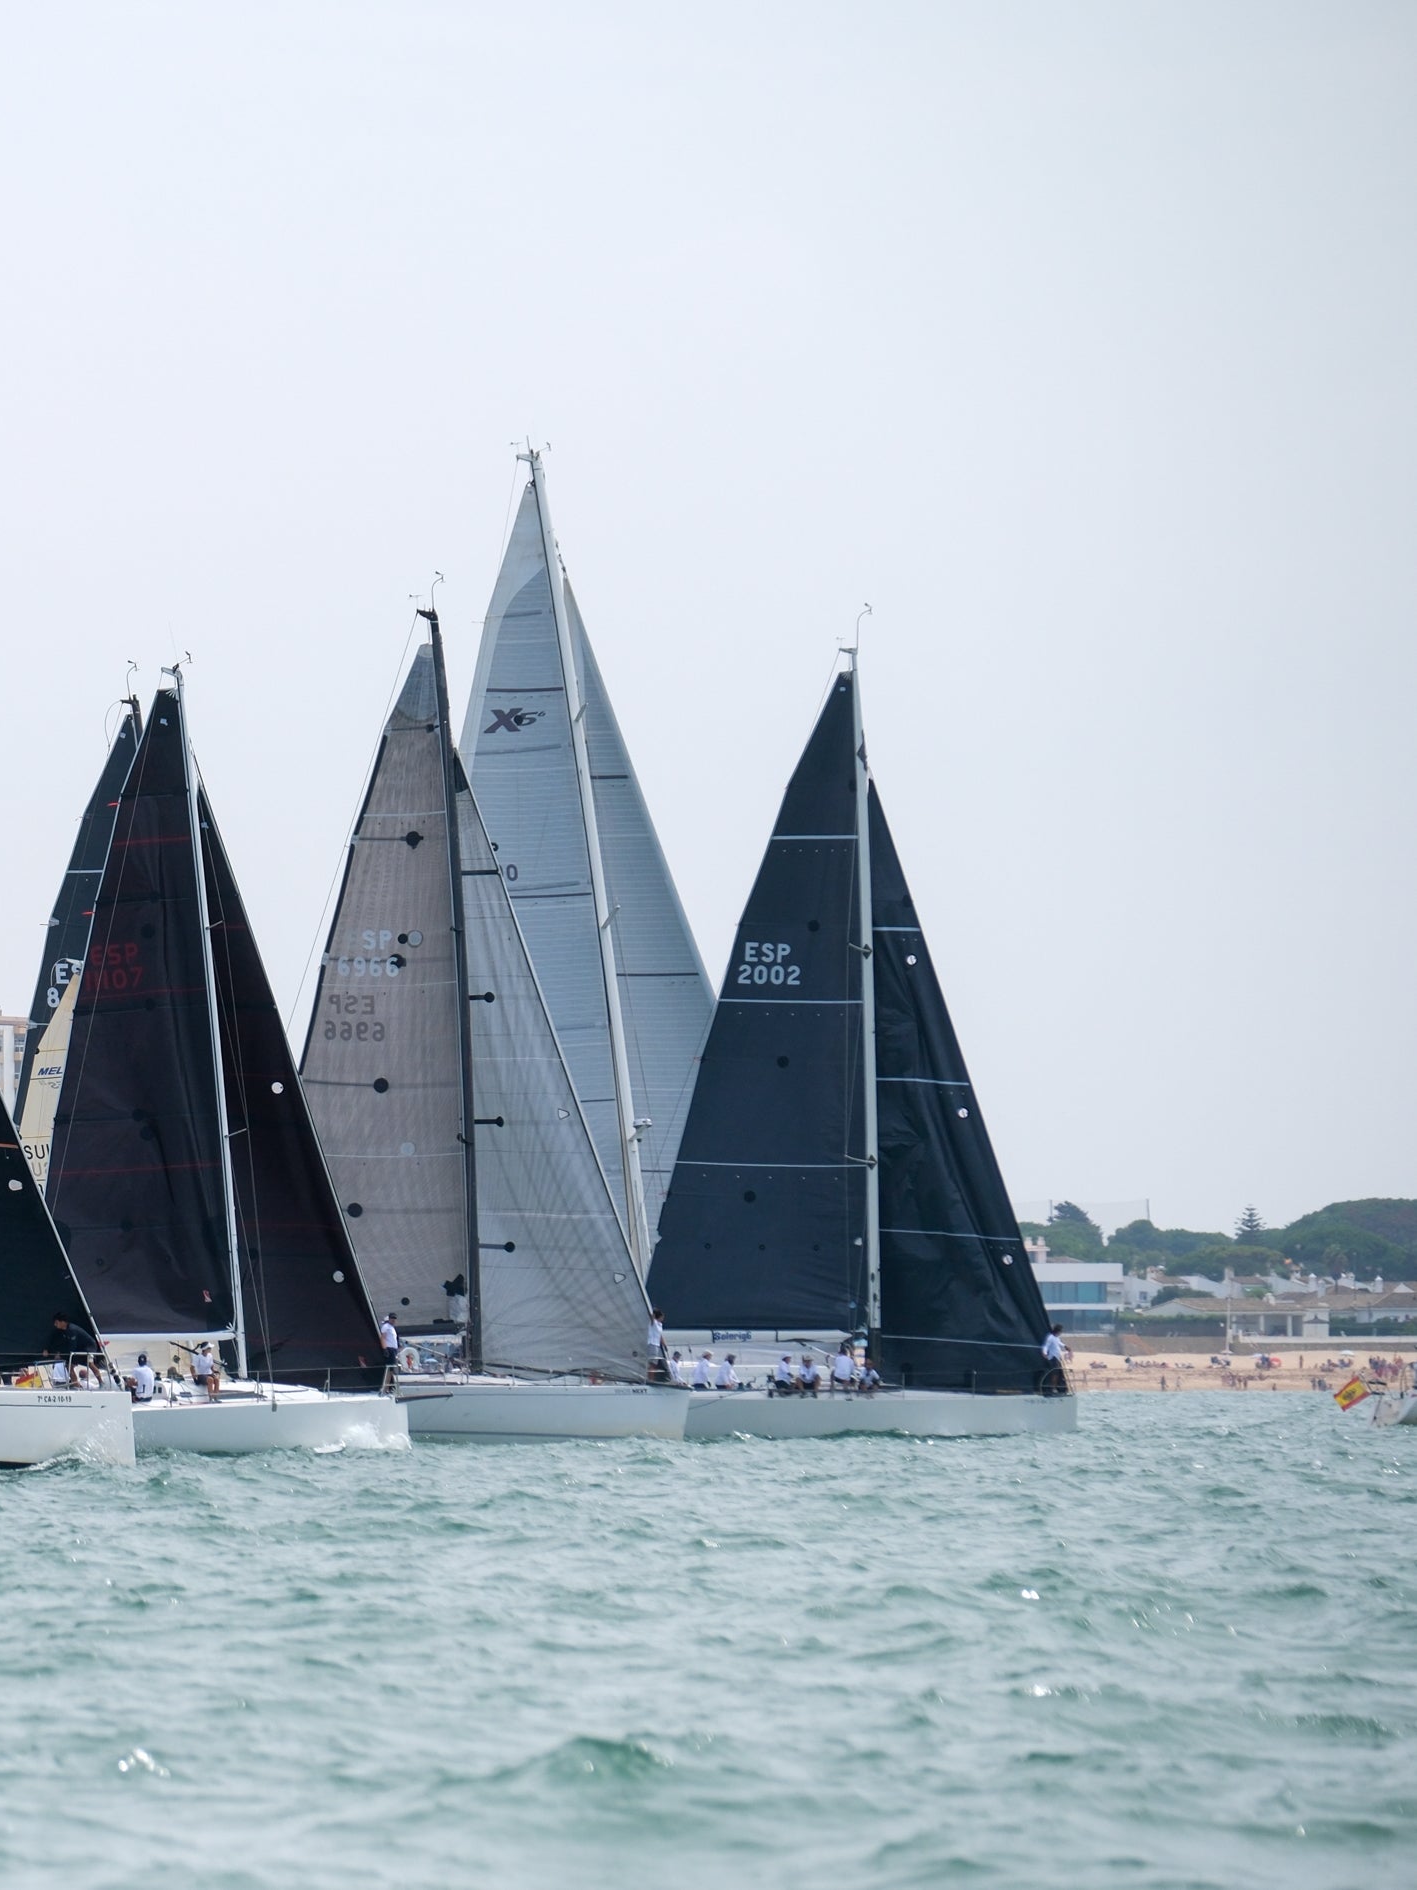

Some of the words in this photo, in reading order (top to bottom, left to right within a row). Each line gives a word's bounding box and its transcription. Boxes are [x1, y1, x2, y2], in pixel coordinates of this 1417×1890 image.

[745, 942, 791, 963] ESP
[337, 956, 400, 978] 6966
[737, 964, 801, 985] 2002
